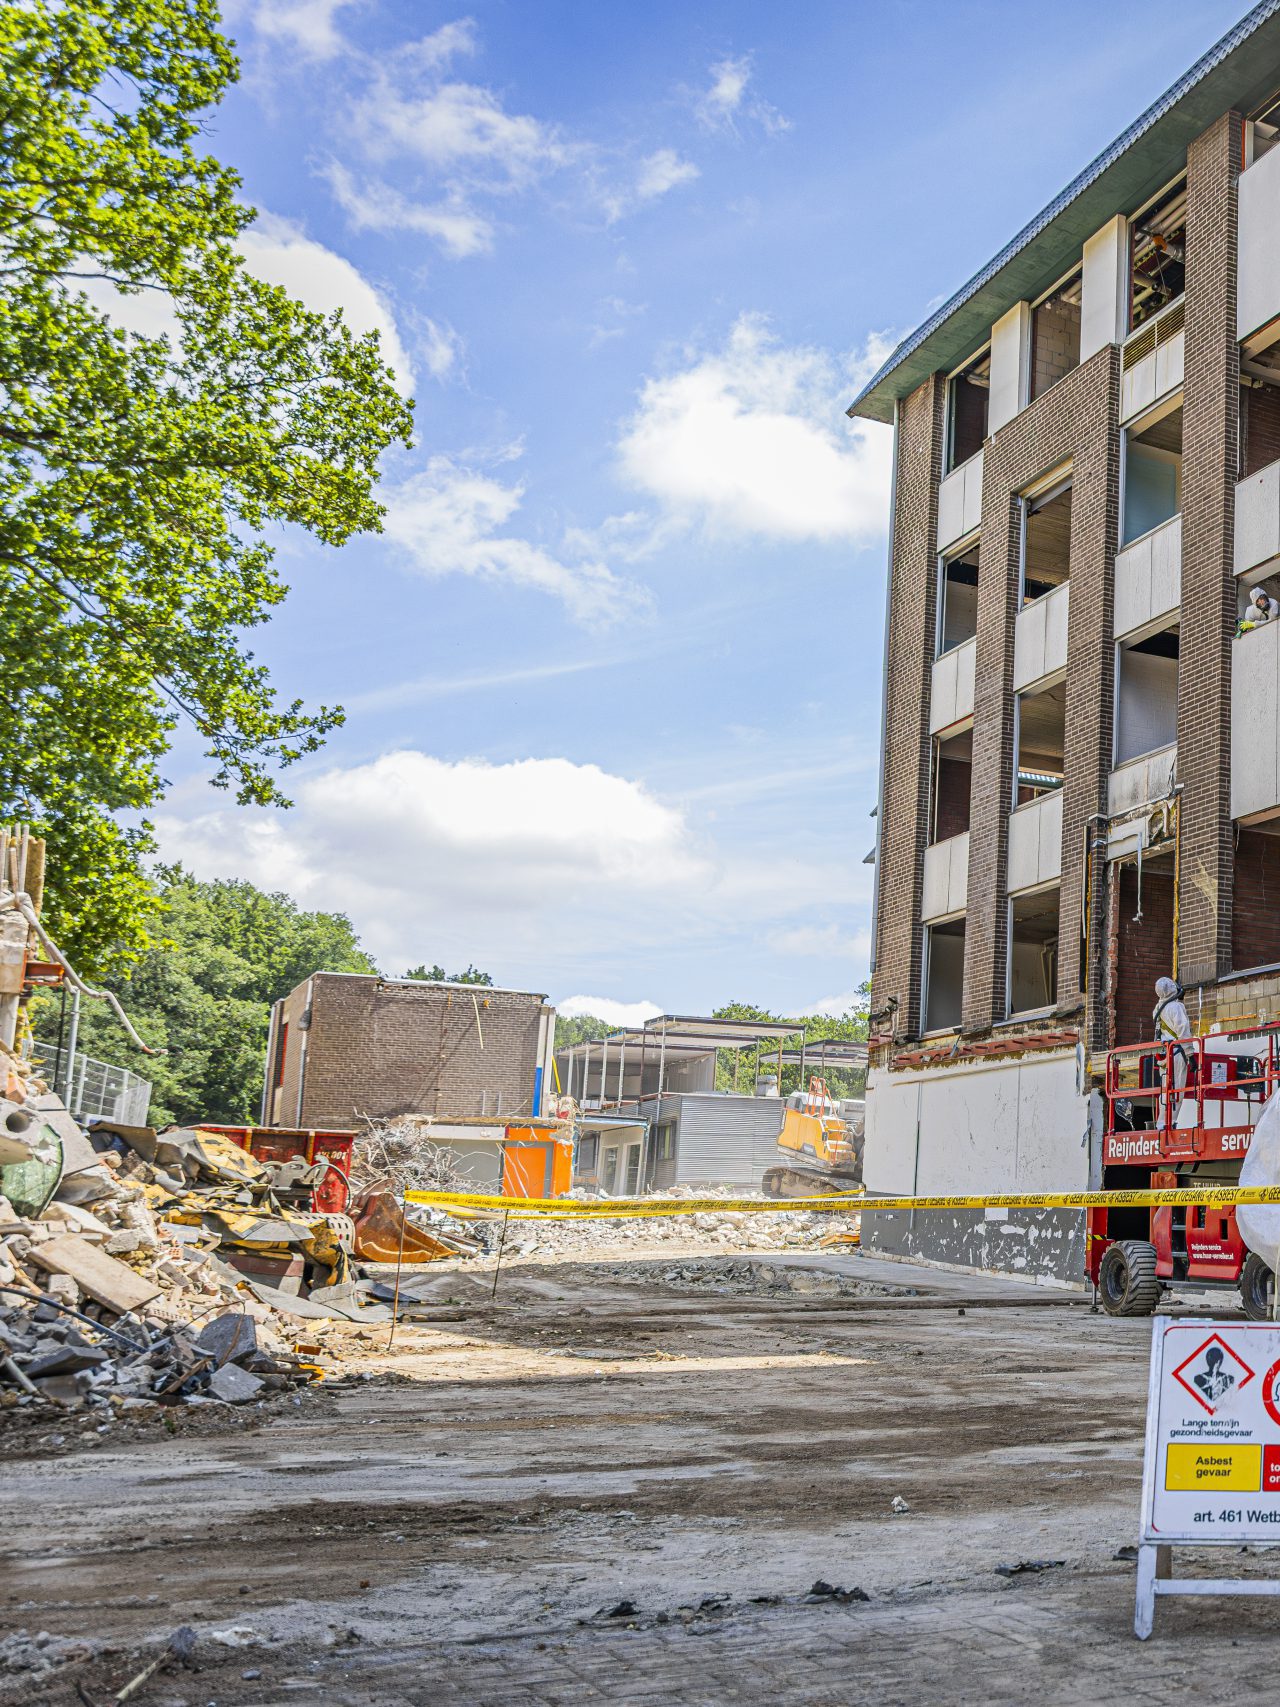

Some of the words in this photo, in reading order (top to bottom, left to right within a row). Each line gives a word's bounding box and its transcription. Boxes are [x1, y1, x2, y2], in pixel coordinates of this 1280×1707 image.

[1108, 1136, 1160, 1162] Reijnders
[1213, 1188, 1241, 1202] ASBEST
[1182, 1418, 1208, 1428] Lange
[1195, 1456, 1233, 1466] Asbest
[1196, 1468, 1232, 1478] gevaar
[1193, 1510, 1215, 1523] art.
[1218, 1510, 1242, 1523] 461
